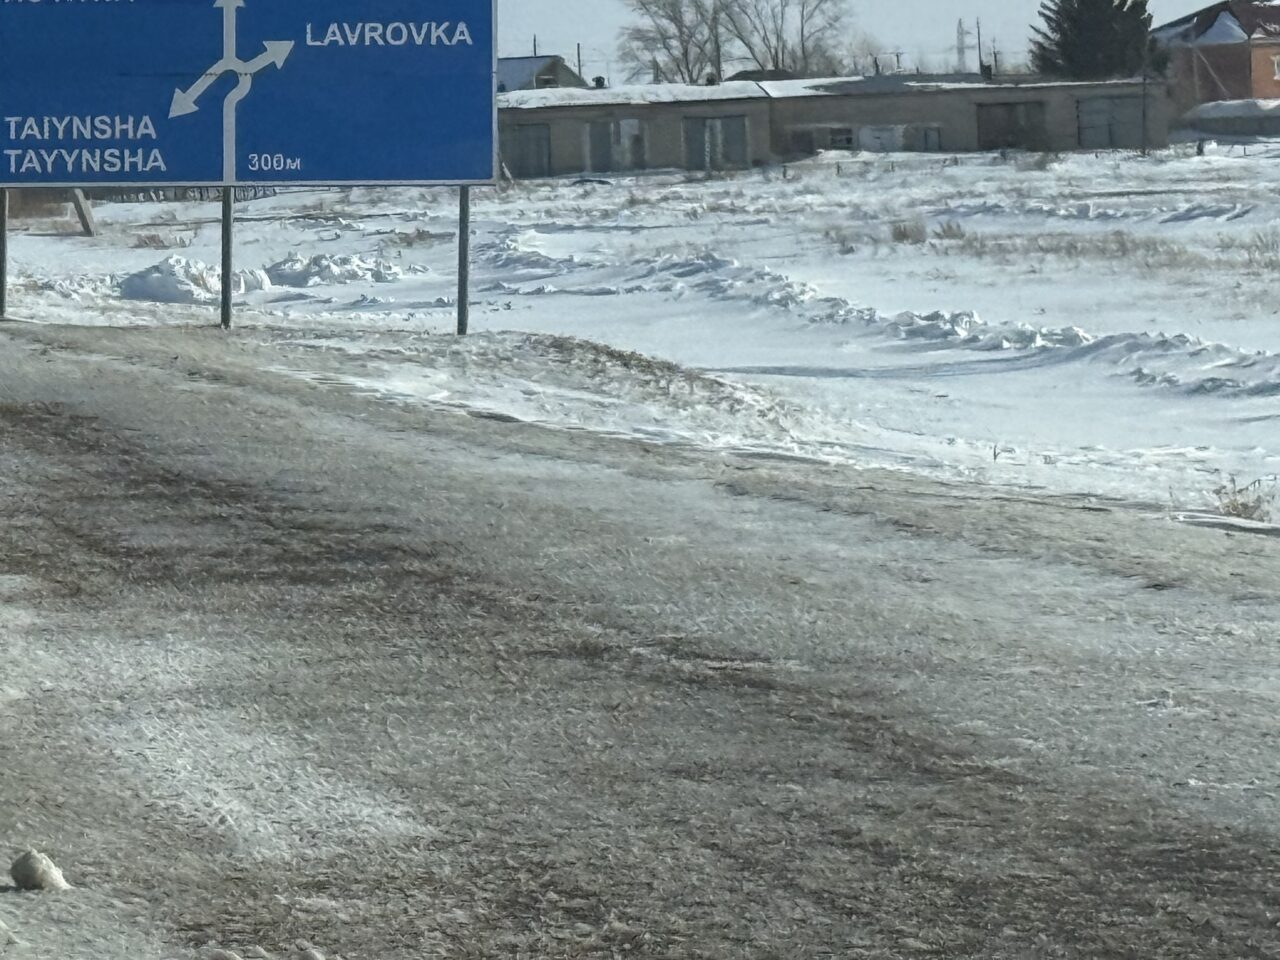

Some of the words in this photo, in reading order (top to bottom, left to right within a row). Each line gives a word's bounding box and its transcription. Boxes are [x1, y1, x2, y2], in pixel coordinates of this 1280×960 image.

[306, 21, 473, 46] LAVROVKA
[4, 115, 157, 140] TAIYNSHA
[3, 148, 167, 174] TAYYNSHA
